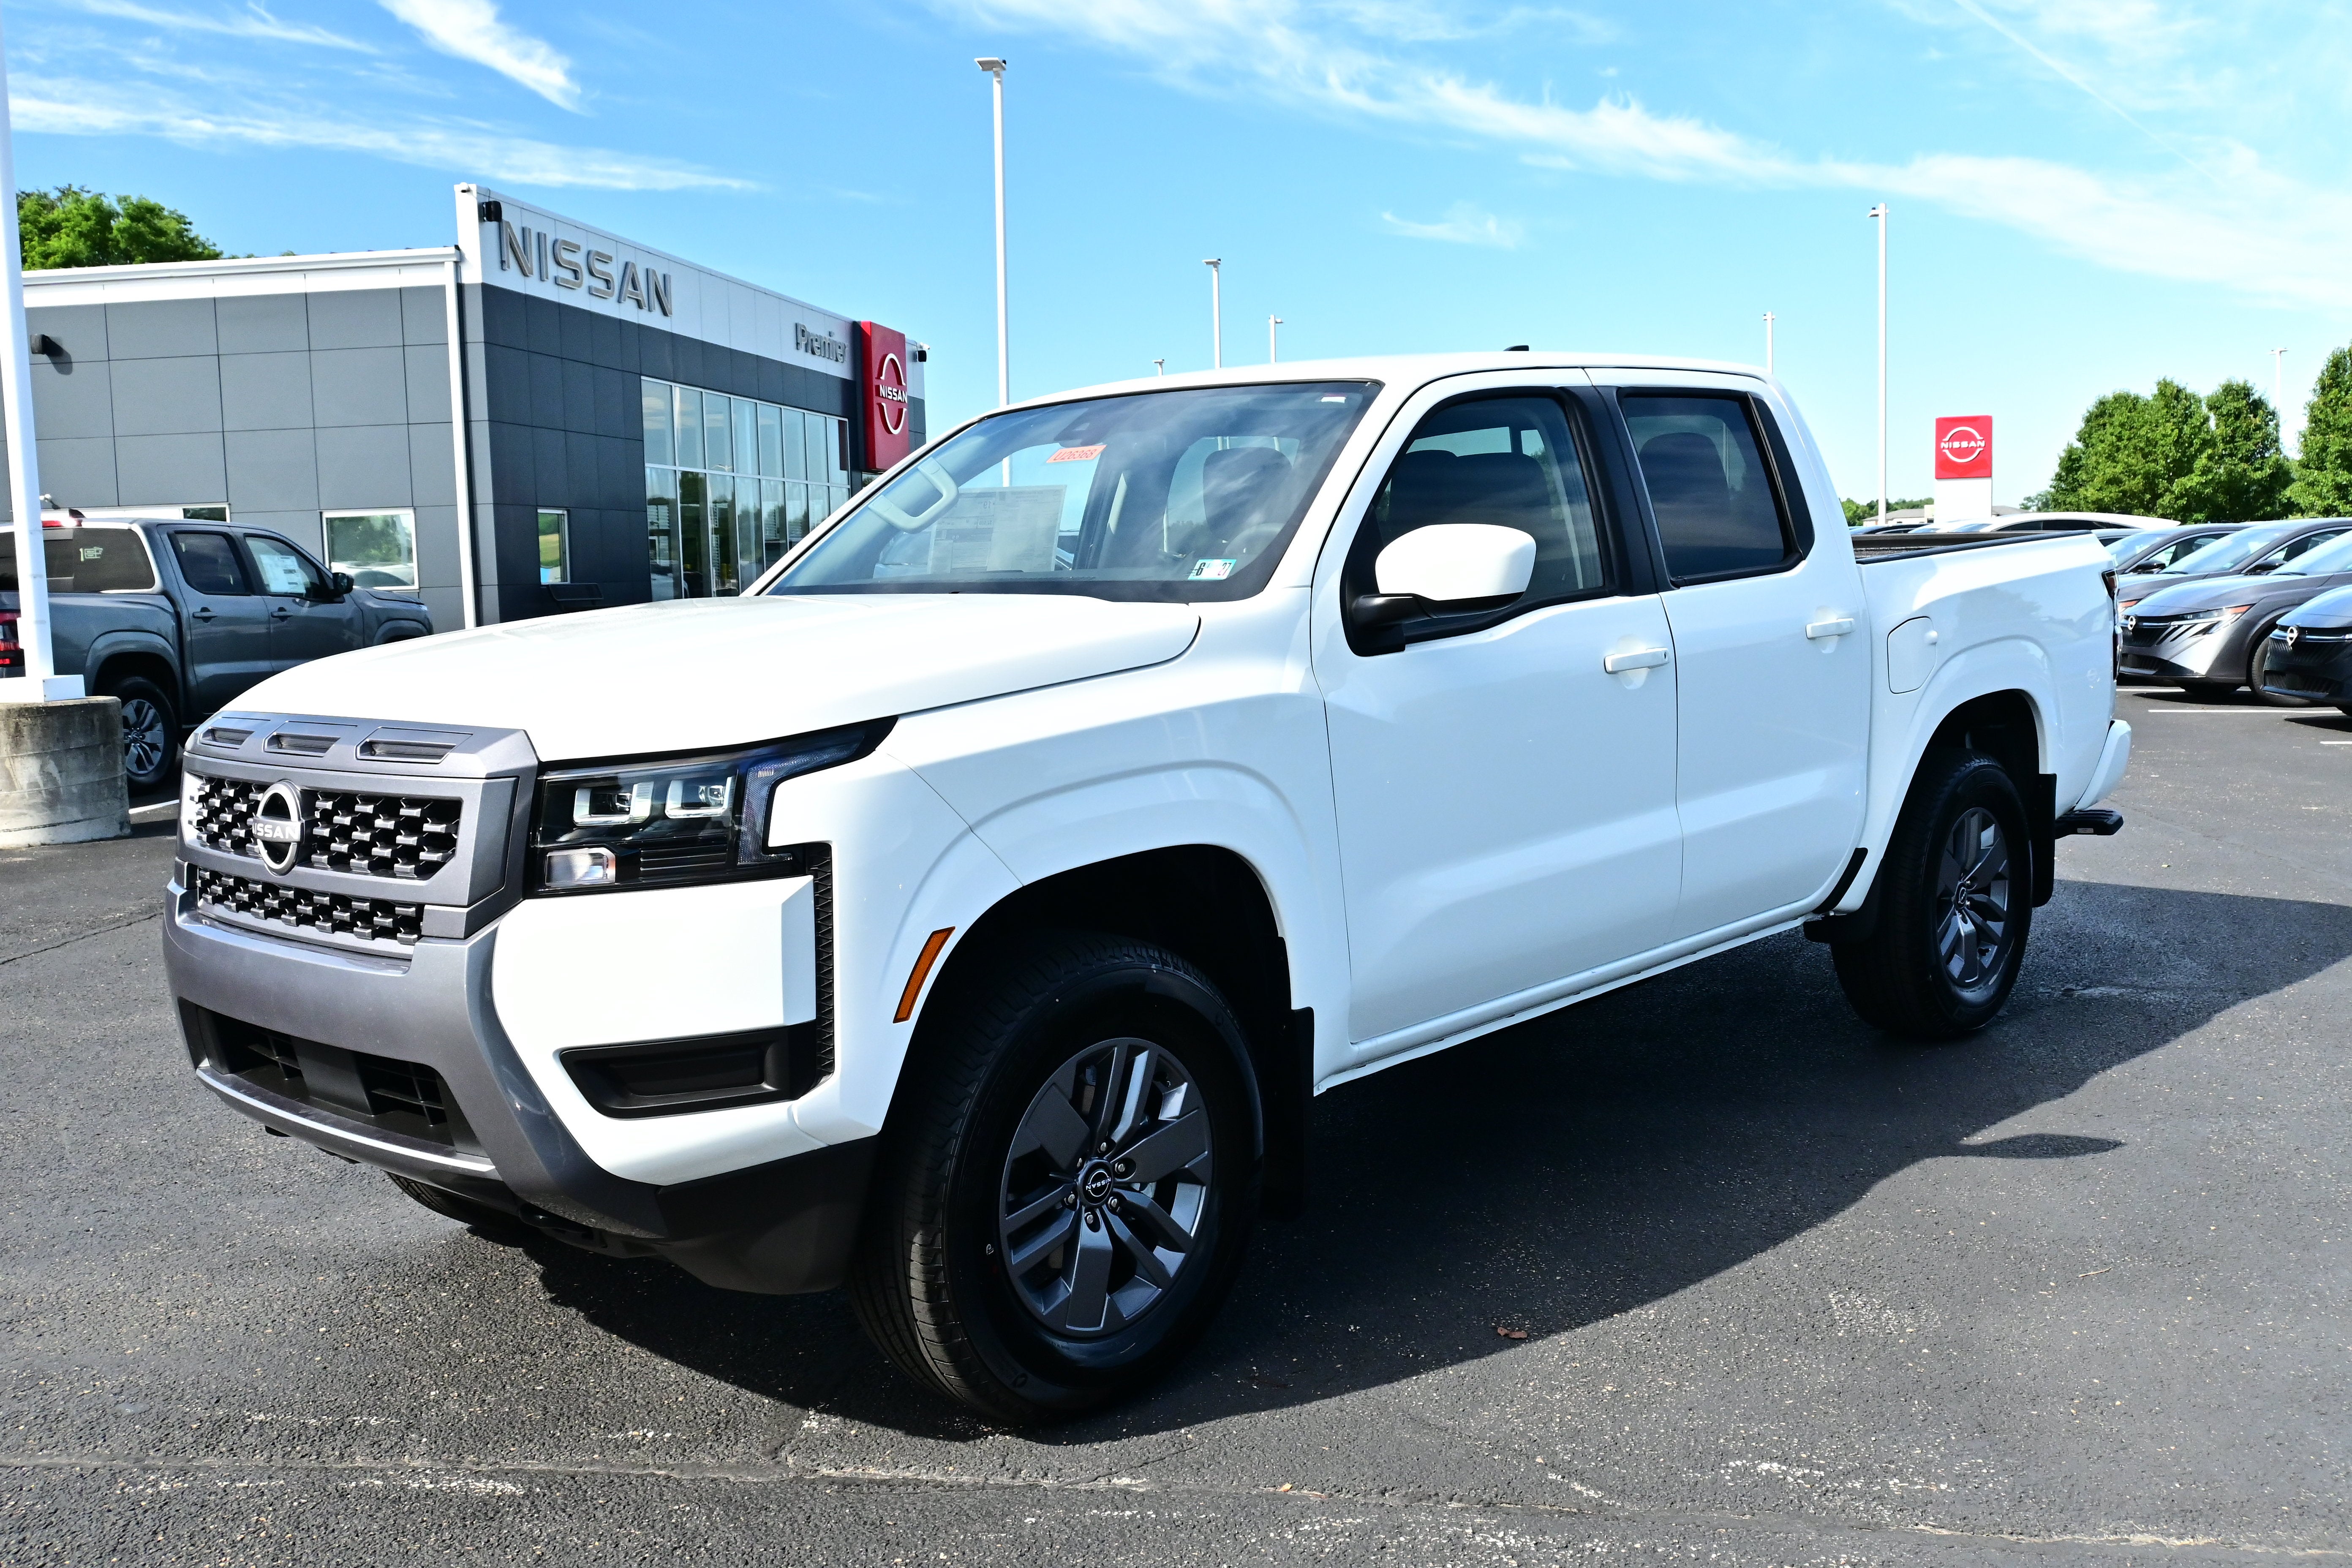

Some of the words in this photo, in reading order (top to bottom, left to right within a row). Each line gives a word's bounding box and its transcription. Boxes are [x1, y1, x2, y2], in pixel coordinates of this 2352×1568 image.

[499, 218, 672, 317] NISSAN
[795, 322, 848, 364] Premier
[879, 384, 908, 403] NISSAN
[1940, 440, 1985, 449] NISSAN
[1195, 562, 1206, 576] 6
[1217, 562, 1232, 576] 27
[1086, 1177, 1111, 1191] NISSAN
